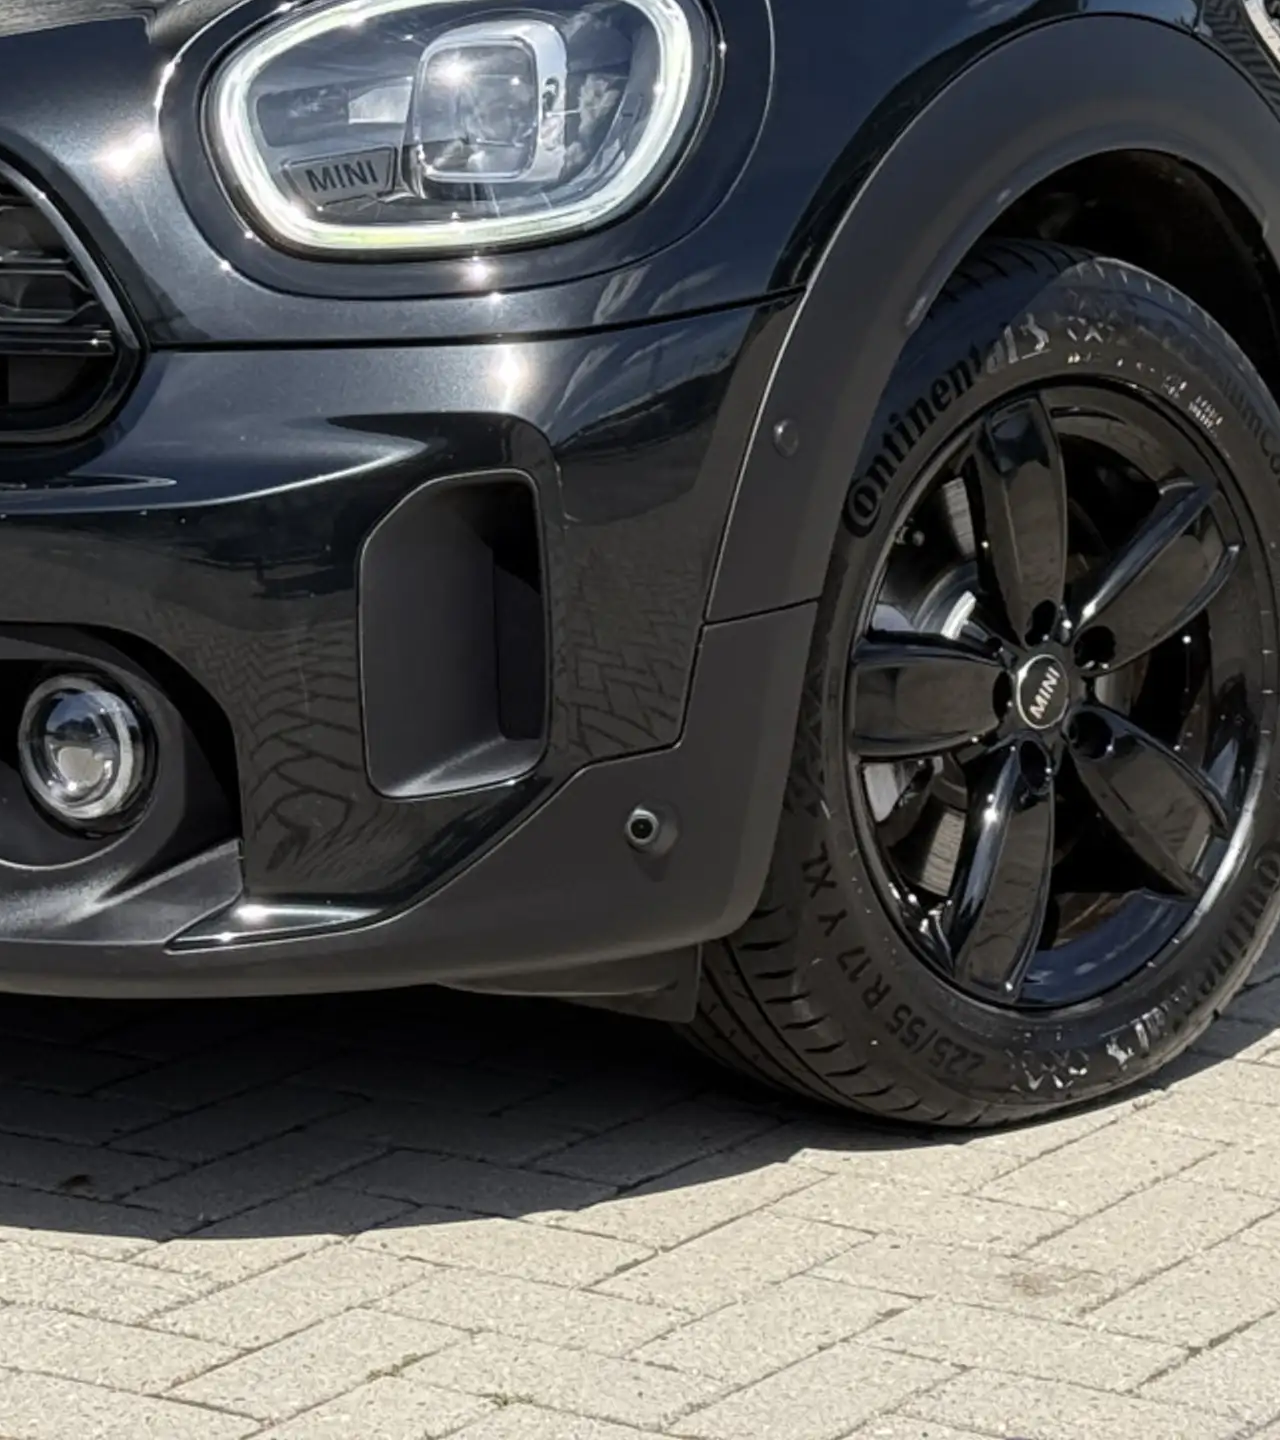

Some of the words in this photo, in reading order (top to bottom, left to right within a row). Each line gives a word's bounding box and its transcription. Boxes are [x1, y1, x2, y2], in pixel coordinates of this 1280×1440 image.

[305, 159, 380, 193] MINI
[842, 324, 1020, 539] Continental
[1029, 665, 1061, 720] MINI
[799, 839, 838, 900] XL
[835, 944, 873, 985] 17
[860, 972, 893, 1011] R
